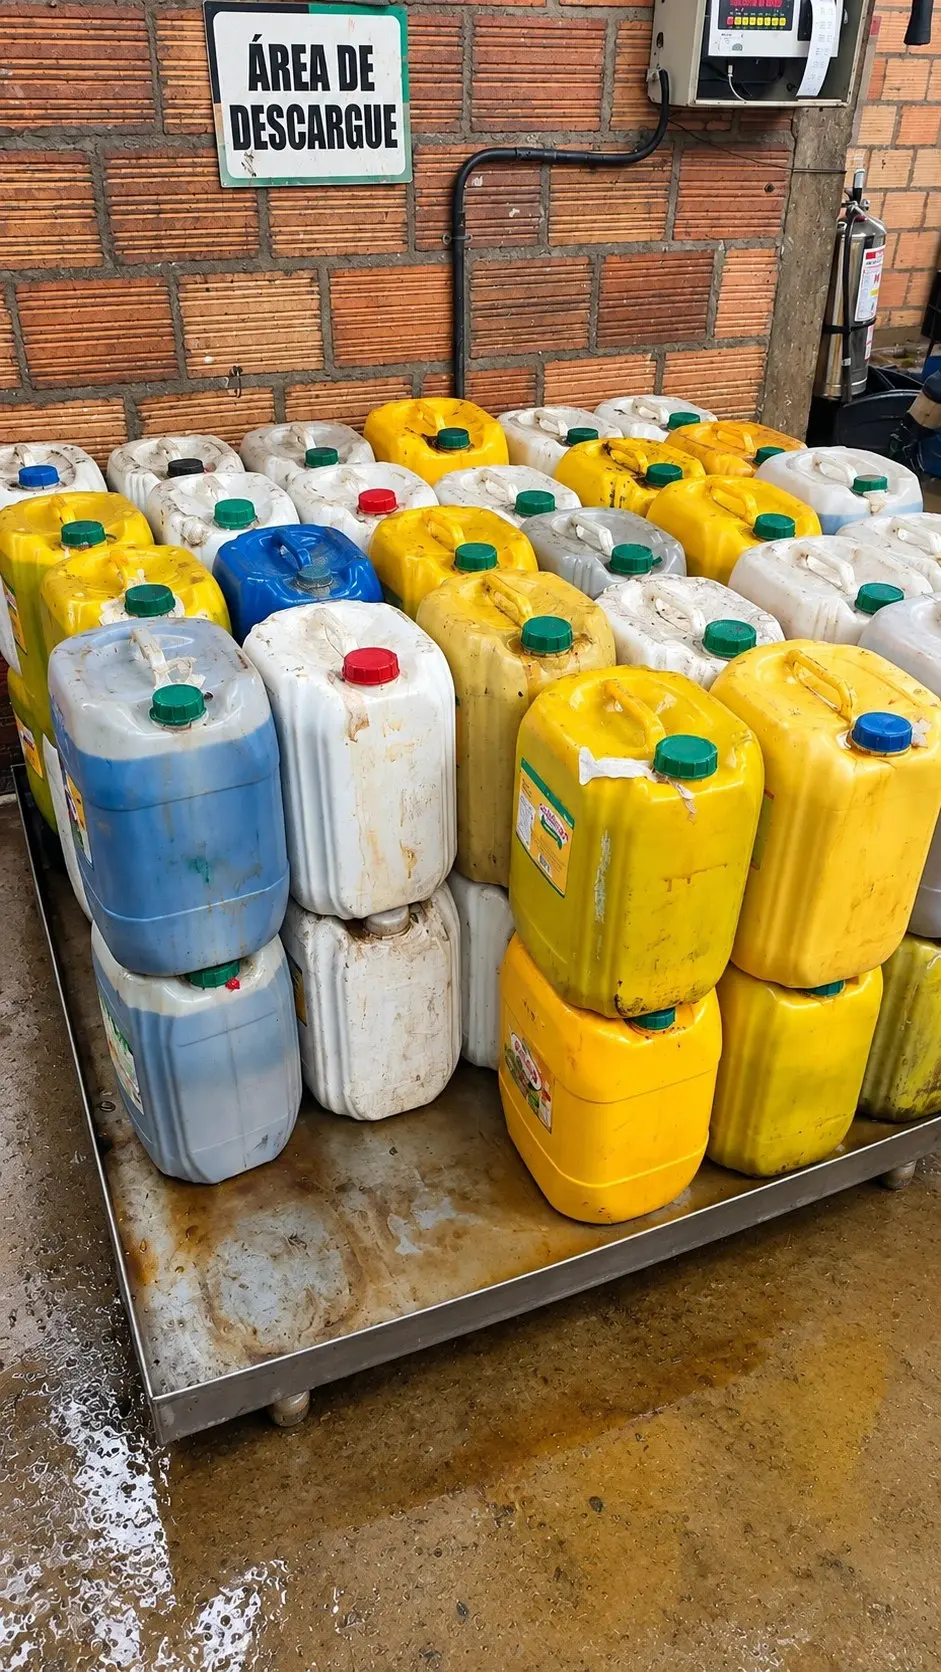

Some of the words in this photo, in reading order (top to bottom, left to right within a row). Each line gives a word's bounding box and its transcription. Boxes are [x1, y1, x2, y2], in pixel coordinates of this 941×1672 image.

[248, 34, 331, 92] ÁREA
[337, 45, 375, 92] DE
[229, 104, 398, 151] DESCARGUE
